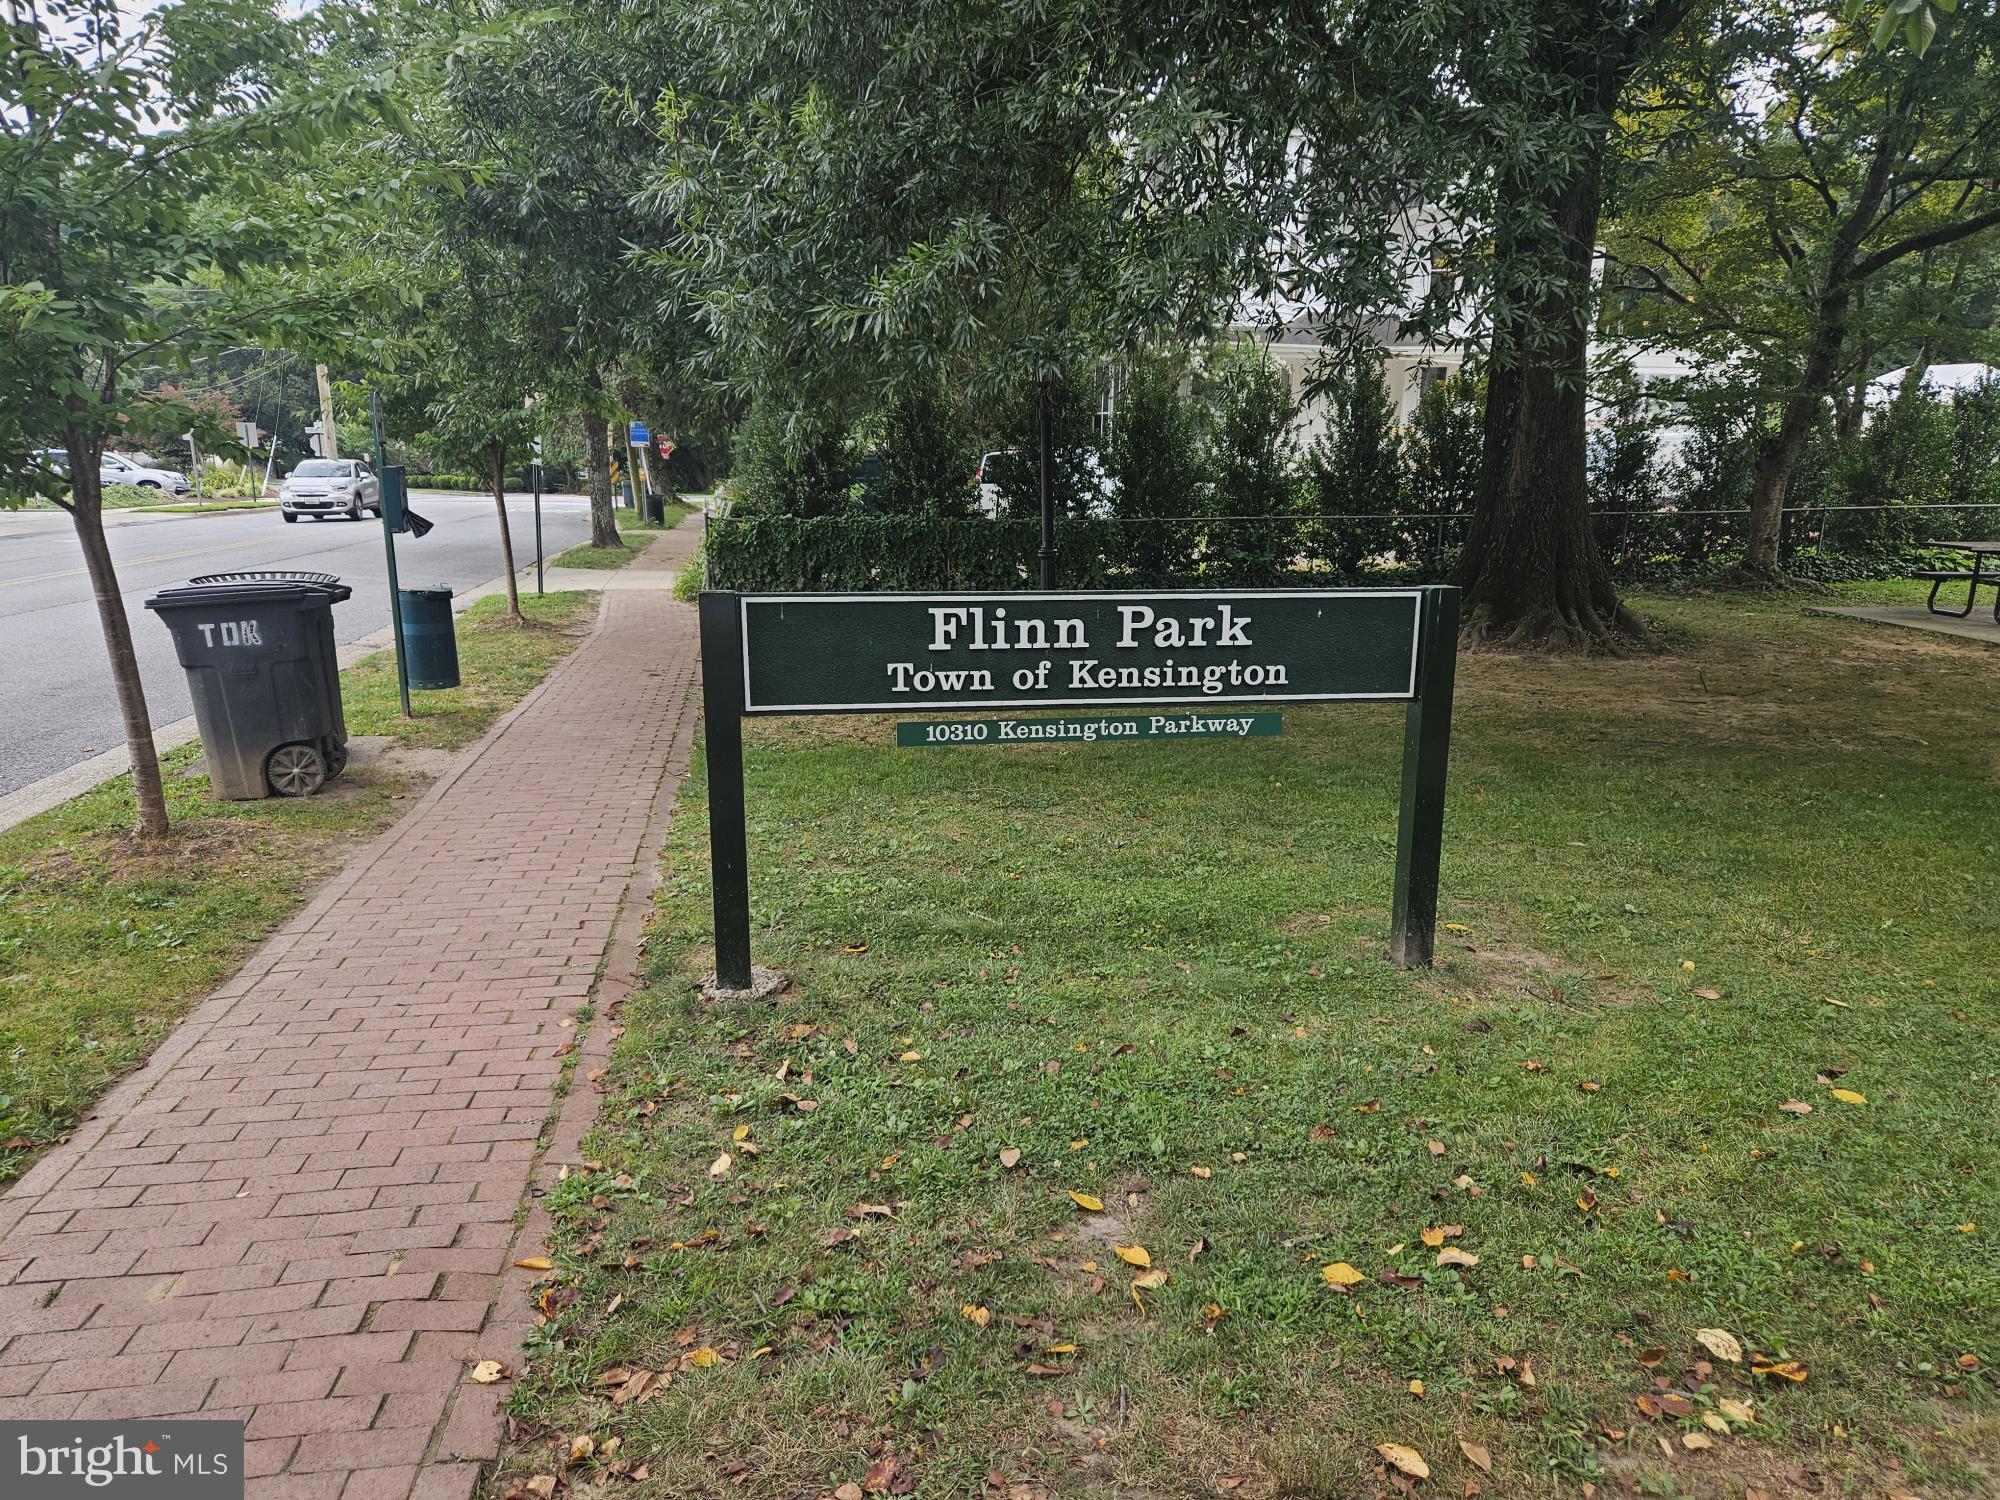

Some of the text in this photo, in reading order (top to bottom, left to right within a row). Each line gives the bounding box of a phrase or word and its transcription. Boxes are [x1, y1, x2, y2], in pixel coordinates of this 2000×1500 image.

[928, 604, 1253, 650] Flinn Park
[887, 659, 1289, 694] Town of Kensington
[926, 715, 1255, 742] 10310 Kensington Parkway
